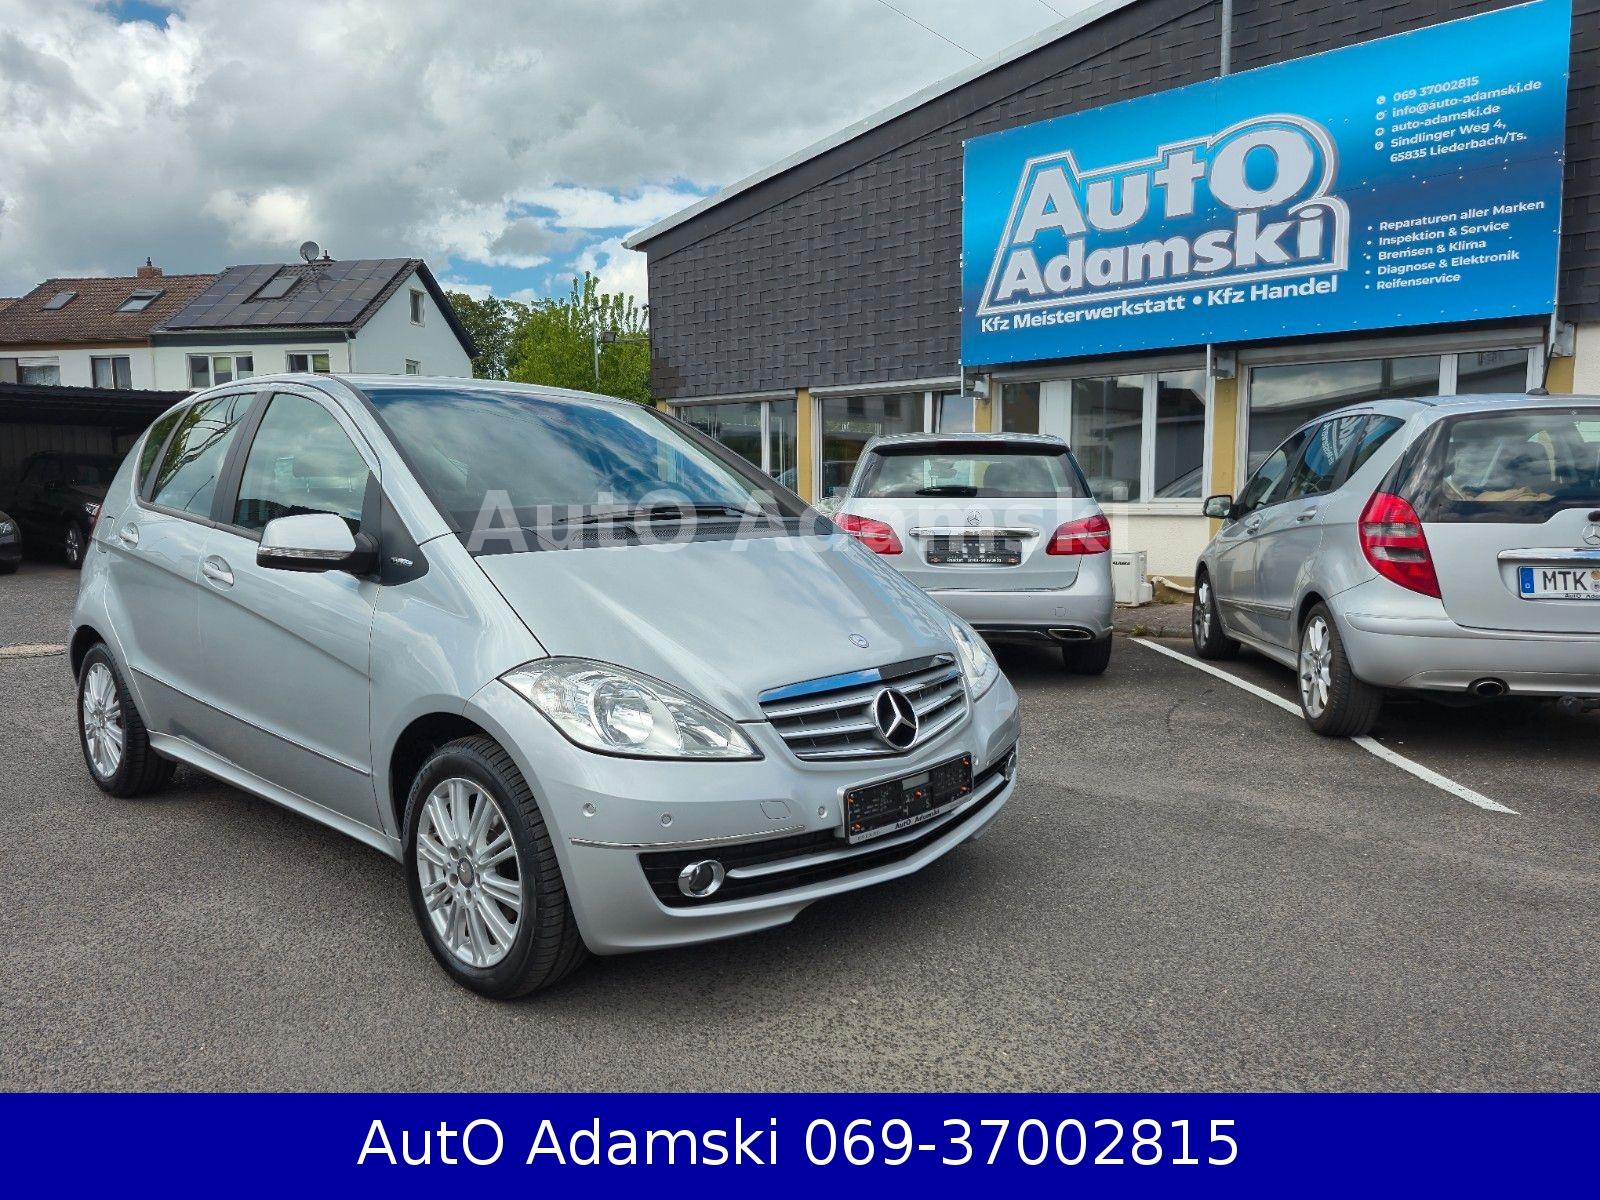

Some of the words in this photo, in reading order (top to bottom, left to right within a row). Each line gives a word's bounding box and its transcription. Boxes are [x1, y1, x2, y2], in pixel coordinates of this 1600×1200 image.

[1392, 80, 1542, 118] info@auto-adamski.de
[1393, 89, 1417, 102] 069
[1420, 75, 1480, 96] 37002815
[1390, 128, 1456, 148] Sindlinger
[1459, 121, 1490, 135] Weg
[1493, 118, 1507, 129] 4,
[1391, 104, 1500, 133] auto-adamski.de
[1390, 147, 1427, 163] 65835
[1429, 131, 1528, 156] Liederbach/Ts.
[1379, 212, 1457, 231] Reparaturen
[1460, 207, 1490, 220] aller
[1492, 200, 1545, 216] Marken
[1379, 230, 1445, 246] Inspektion
[1448, 227, 1457, 237] &
[1460, 221, 1510, 235] Service
[996, 207, 1325, 300] Adamski
[1377, 260, 1436, 276] Diagnose
[1438, 258, 1448, 268] &
[1451, 250, 1520, 267] Elektronik
[1378, 246, 1433, 261] Bremsen
[1436, 244, 1446, 254] &
[1449, 239, 1487, 252] Klima
[1376, 272, 1462, 290] Reifenservice
[981, 317, 1010, 333] Kfz
[1013, 295, 1186, 330] Meisterwerkstatt
[1207, 287, 1245, 307] Kfz
[1251, 275, 1338, 302] Handel
[1542, 570, 1588, 591] MTK
